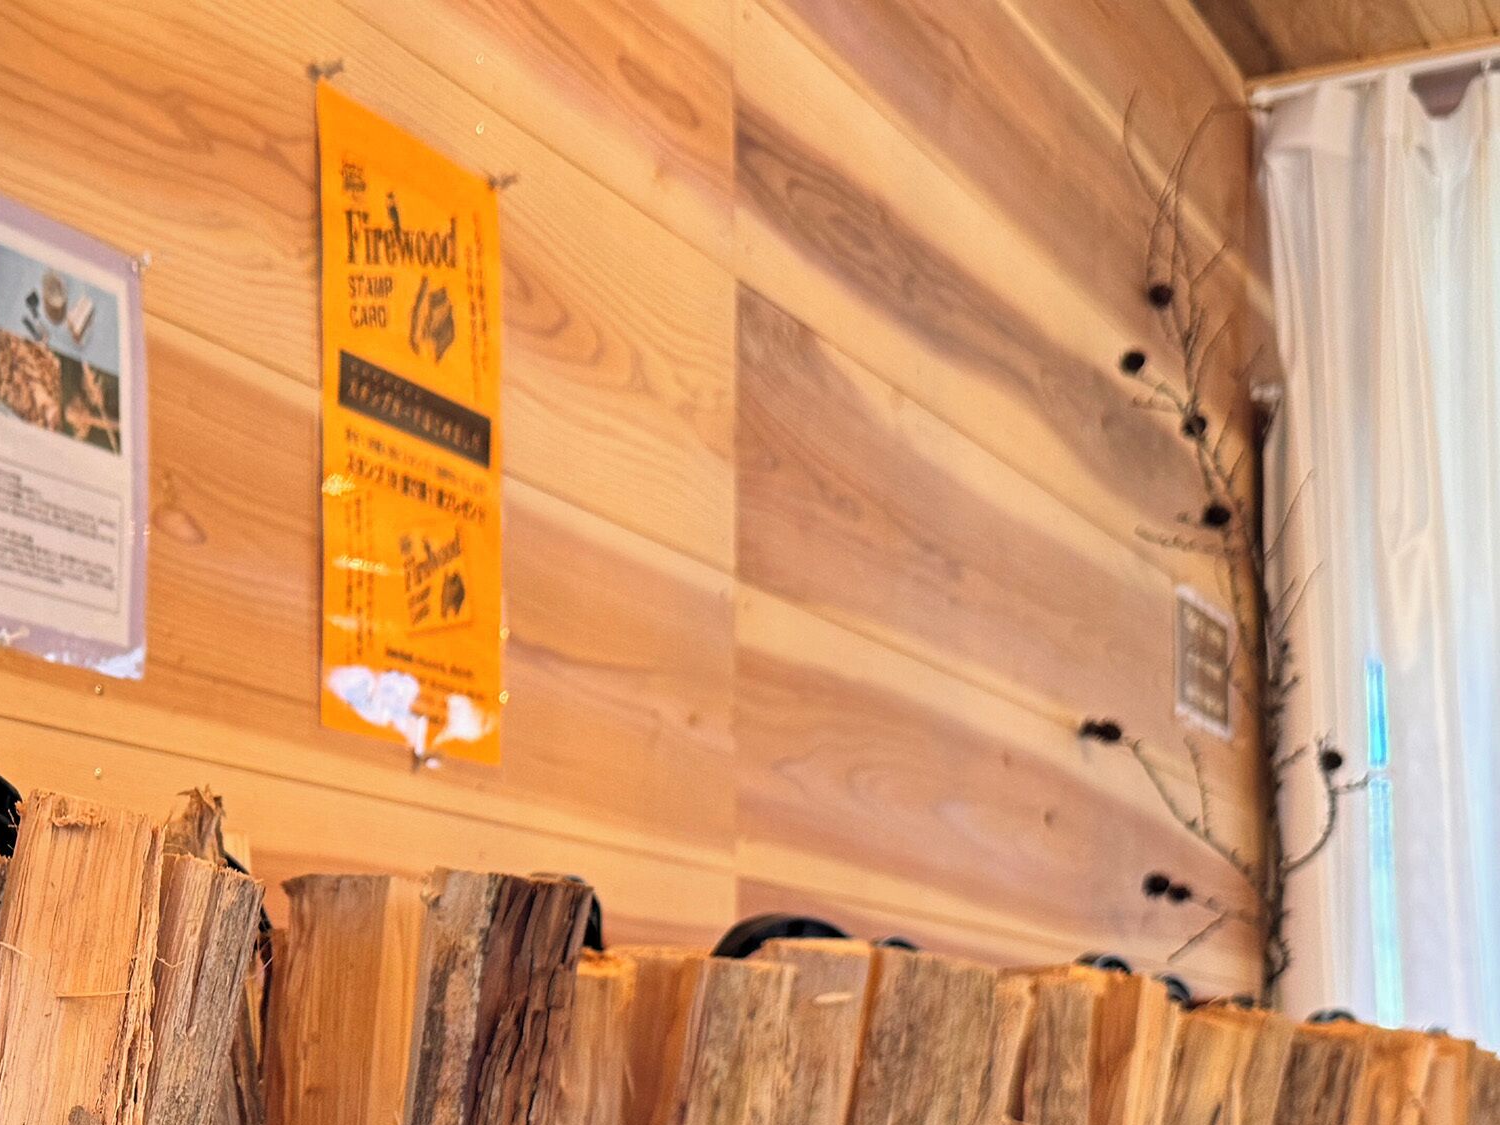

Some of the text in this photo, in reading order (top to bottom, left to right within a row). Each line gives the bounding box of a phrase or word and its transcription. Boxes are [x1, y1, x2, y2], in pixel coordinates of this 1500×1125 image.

[345, 209, 457, 268] Firewood
[349, 274, 394, 299] STAMP
[350, 304, 387, 329] CARD
